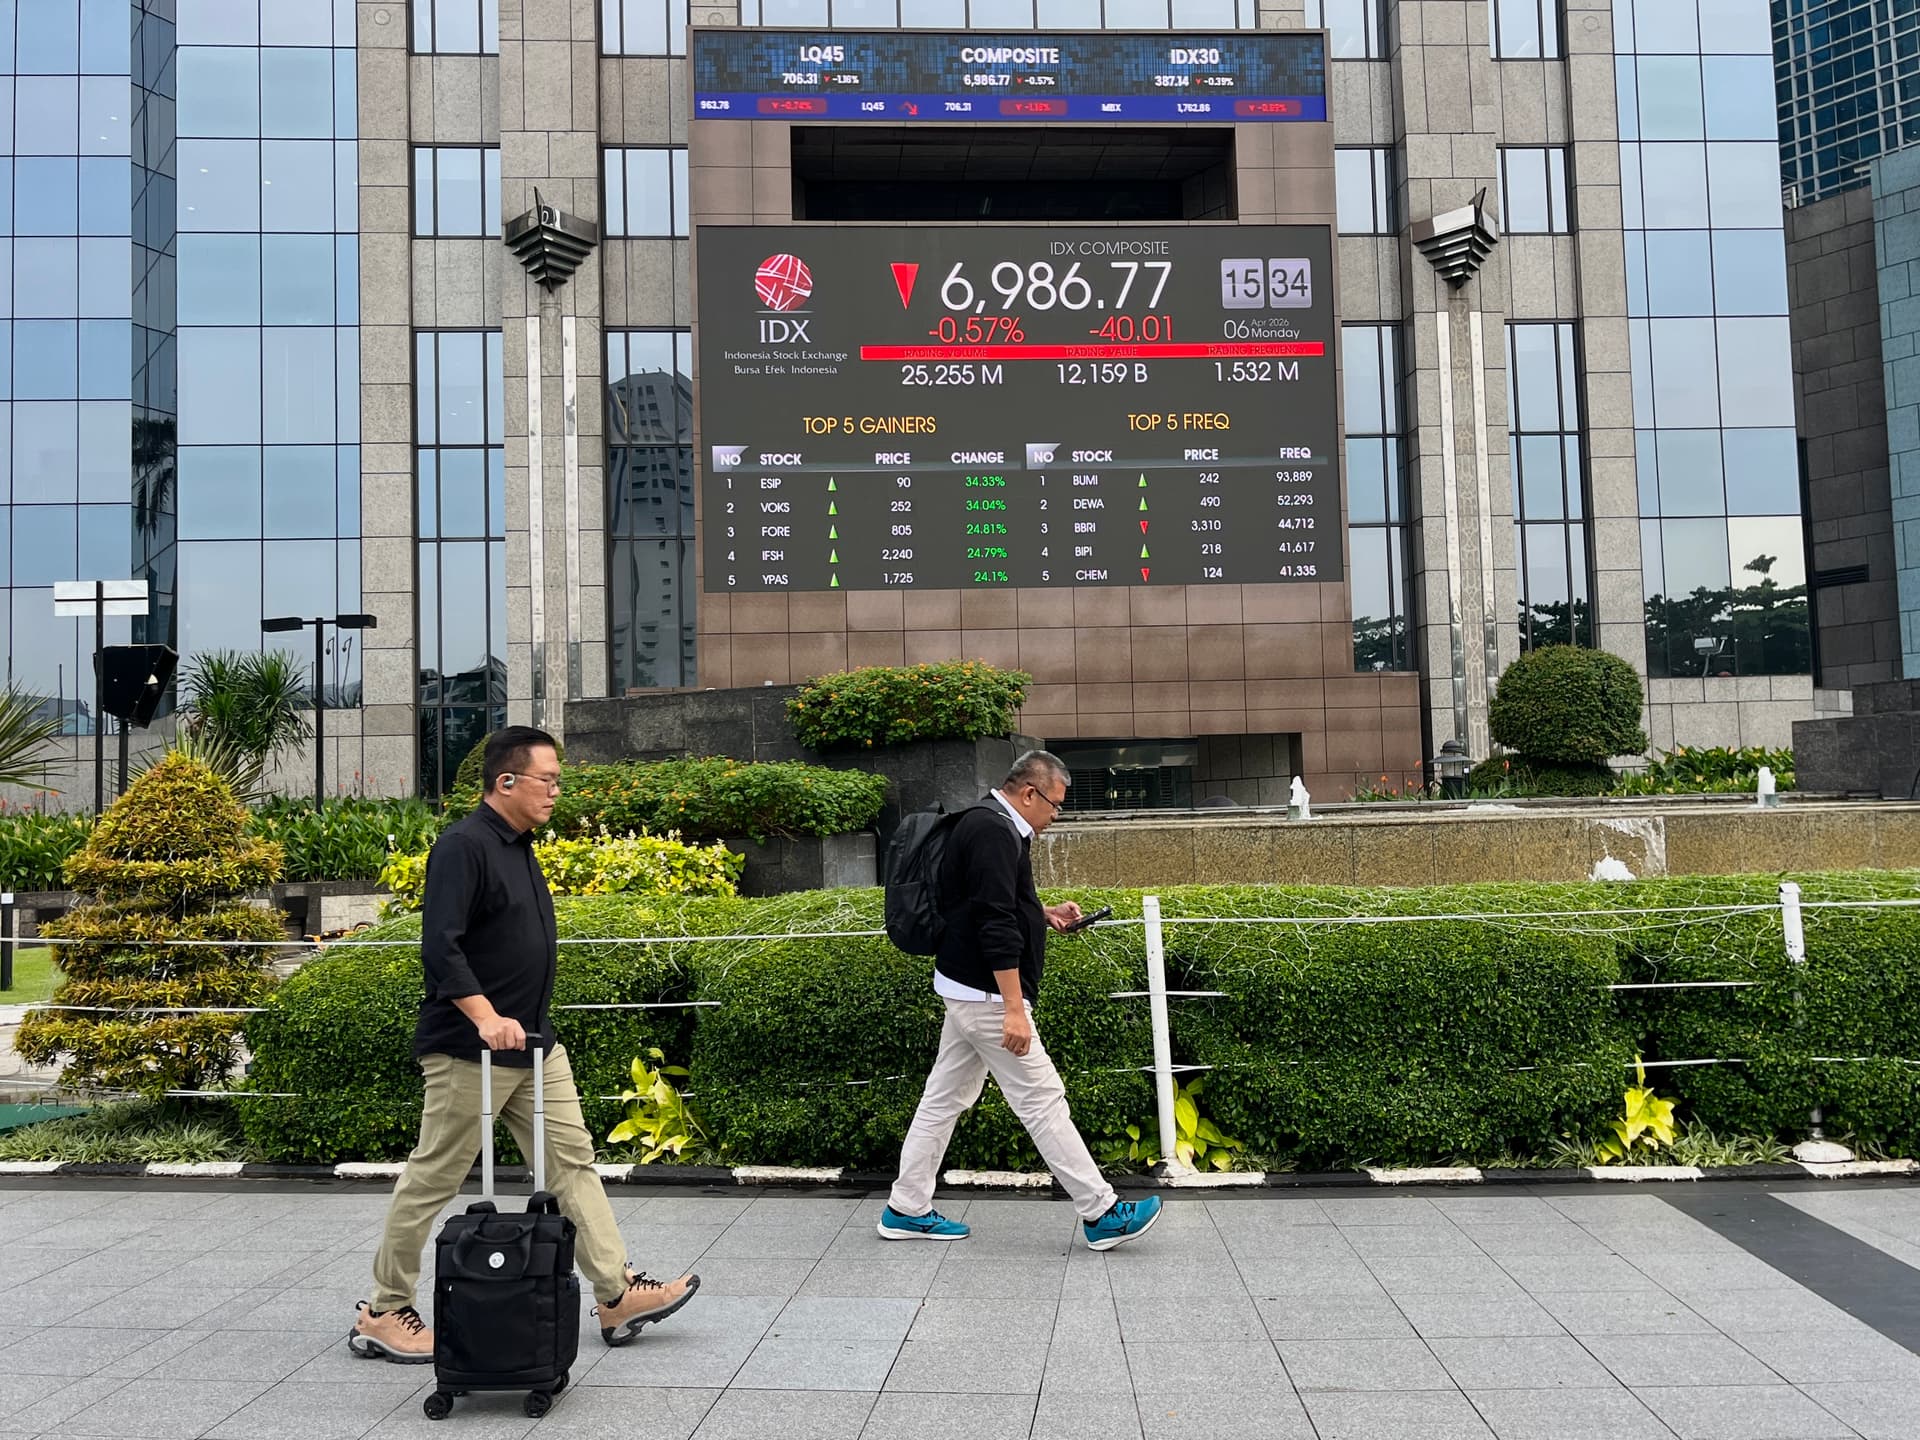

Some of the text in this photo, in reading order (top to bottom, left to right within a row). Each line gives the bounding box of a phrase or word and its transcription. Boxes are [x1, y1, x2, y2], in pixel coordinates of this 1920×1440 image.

[800, 46, 844, 64] LQ45
[961, 48, 1059, 63] COMPOSITE
[1170, 49, 1219, 64] IDX30
[782, 73, 817, 84] 706.31
[963, 75, 1055, 87] 6,986.77 -0.57%
[1154, 76, 1234, 87] 387.14 -0.39%
[861, 102, 884, 111] LQ45
[944, 102, 971, 111] 706.31
[1050, 241, 1169, 256] IDX COMPOSITE
[941, 261, 1172, 314] 6,986.77
[1226, 268, 1308, 298] 15 34
[928, 315, 1172, 343] -0.57% -40.01
[1224, 319, 1250, 339] 06
[1251, 318, 1290, 328] Apr 2026
[759, 320, 811, 344] IDX
[1251, 328, 1300, 340] Monday
[724, 351, 848, 362] Indonesia Stock Exchange
[903, 348, 988, 358] TRADING VOLUME
[1064, 346, 1138, 357] TRADING VALUE
[1207, 346, 1248, 355] TRADING
[734, 365, 838, 375] Bursa Efek Indonesia
[901, 364, 1003, 386] 25,255 M
[1057, 363, 1148, 385] 12,159 B
[1215, 361, 1299, 382] 1.532 M
[803, 416, 936, 434] TOP 5 GAINERS
[1128, 413, 1230, 431] TOP 5 FREQ
[720, 452, 1004, 466] NO STOCK PRICE CHANGE
[1034, 447, 1311, 463] NO STOCK PRICE FREQ
[727, 476, 1005, 489] 1 ESIP 90 34.33%
[1040, 471, 1312, 486] 1 BUMI 242 93,889
[727, 500, 1006, 513] 2 VOKS 252 34.04%
[1040, 495, 1313, 510] 2 DEWA 490 52,293
[727, 523, 1007, 537] 3 FORE 805 24.81%
[1041, 518, 1315, 534] 3 BBRI 3,310 44,712
[728, 548, 1007, 561] 4 IFSH 2,240 24.79%
[1041, 542, 1315, 557] 4 BIPI 218 41,617
[728, 571, 1008, 585] 5 YPAS 1,725 24.1%
[1042, 565, 1316, 581] 5 CHEM 124 41,335
